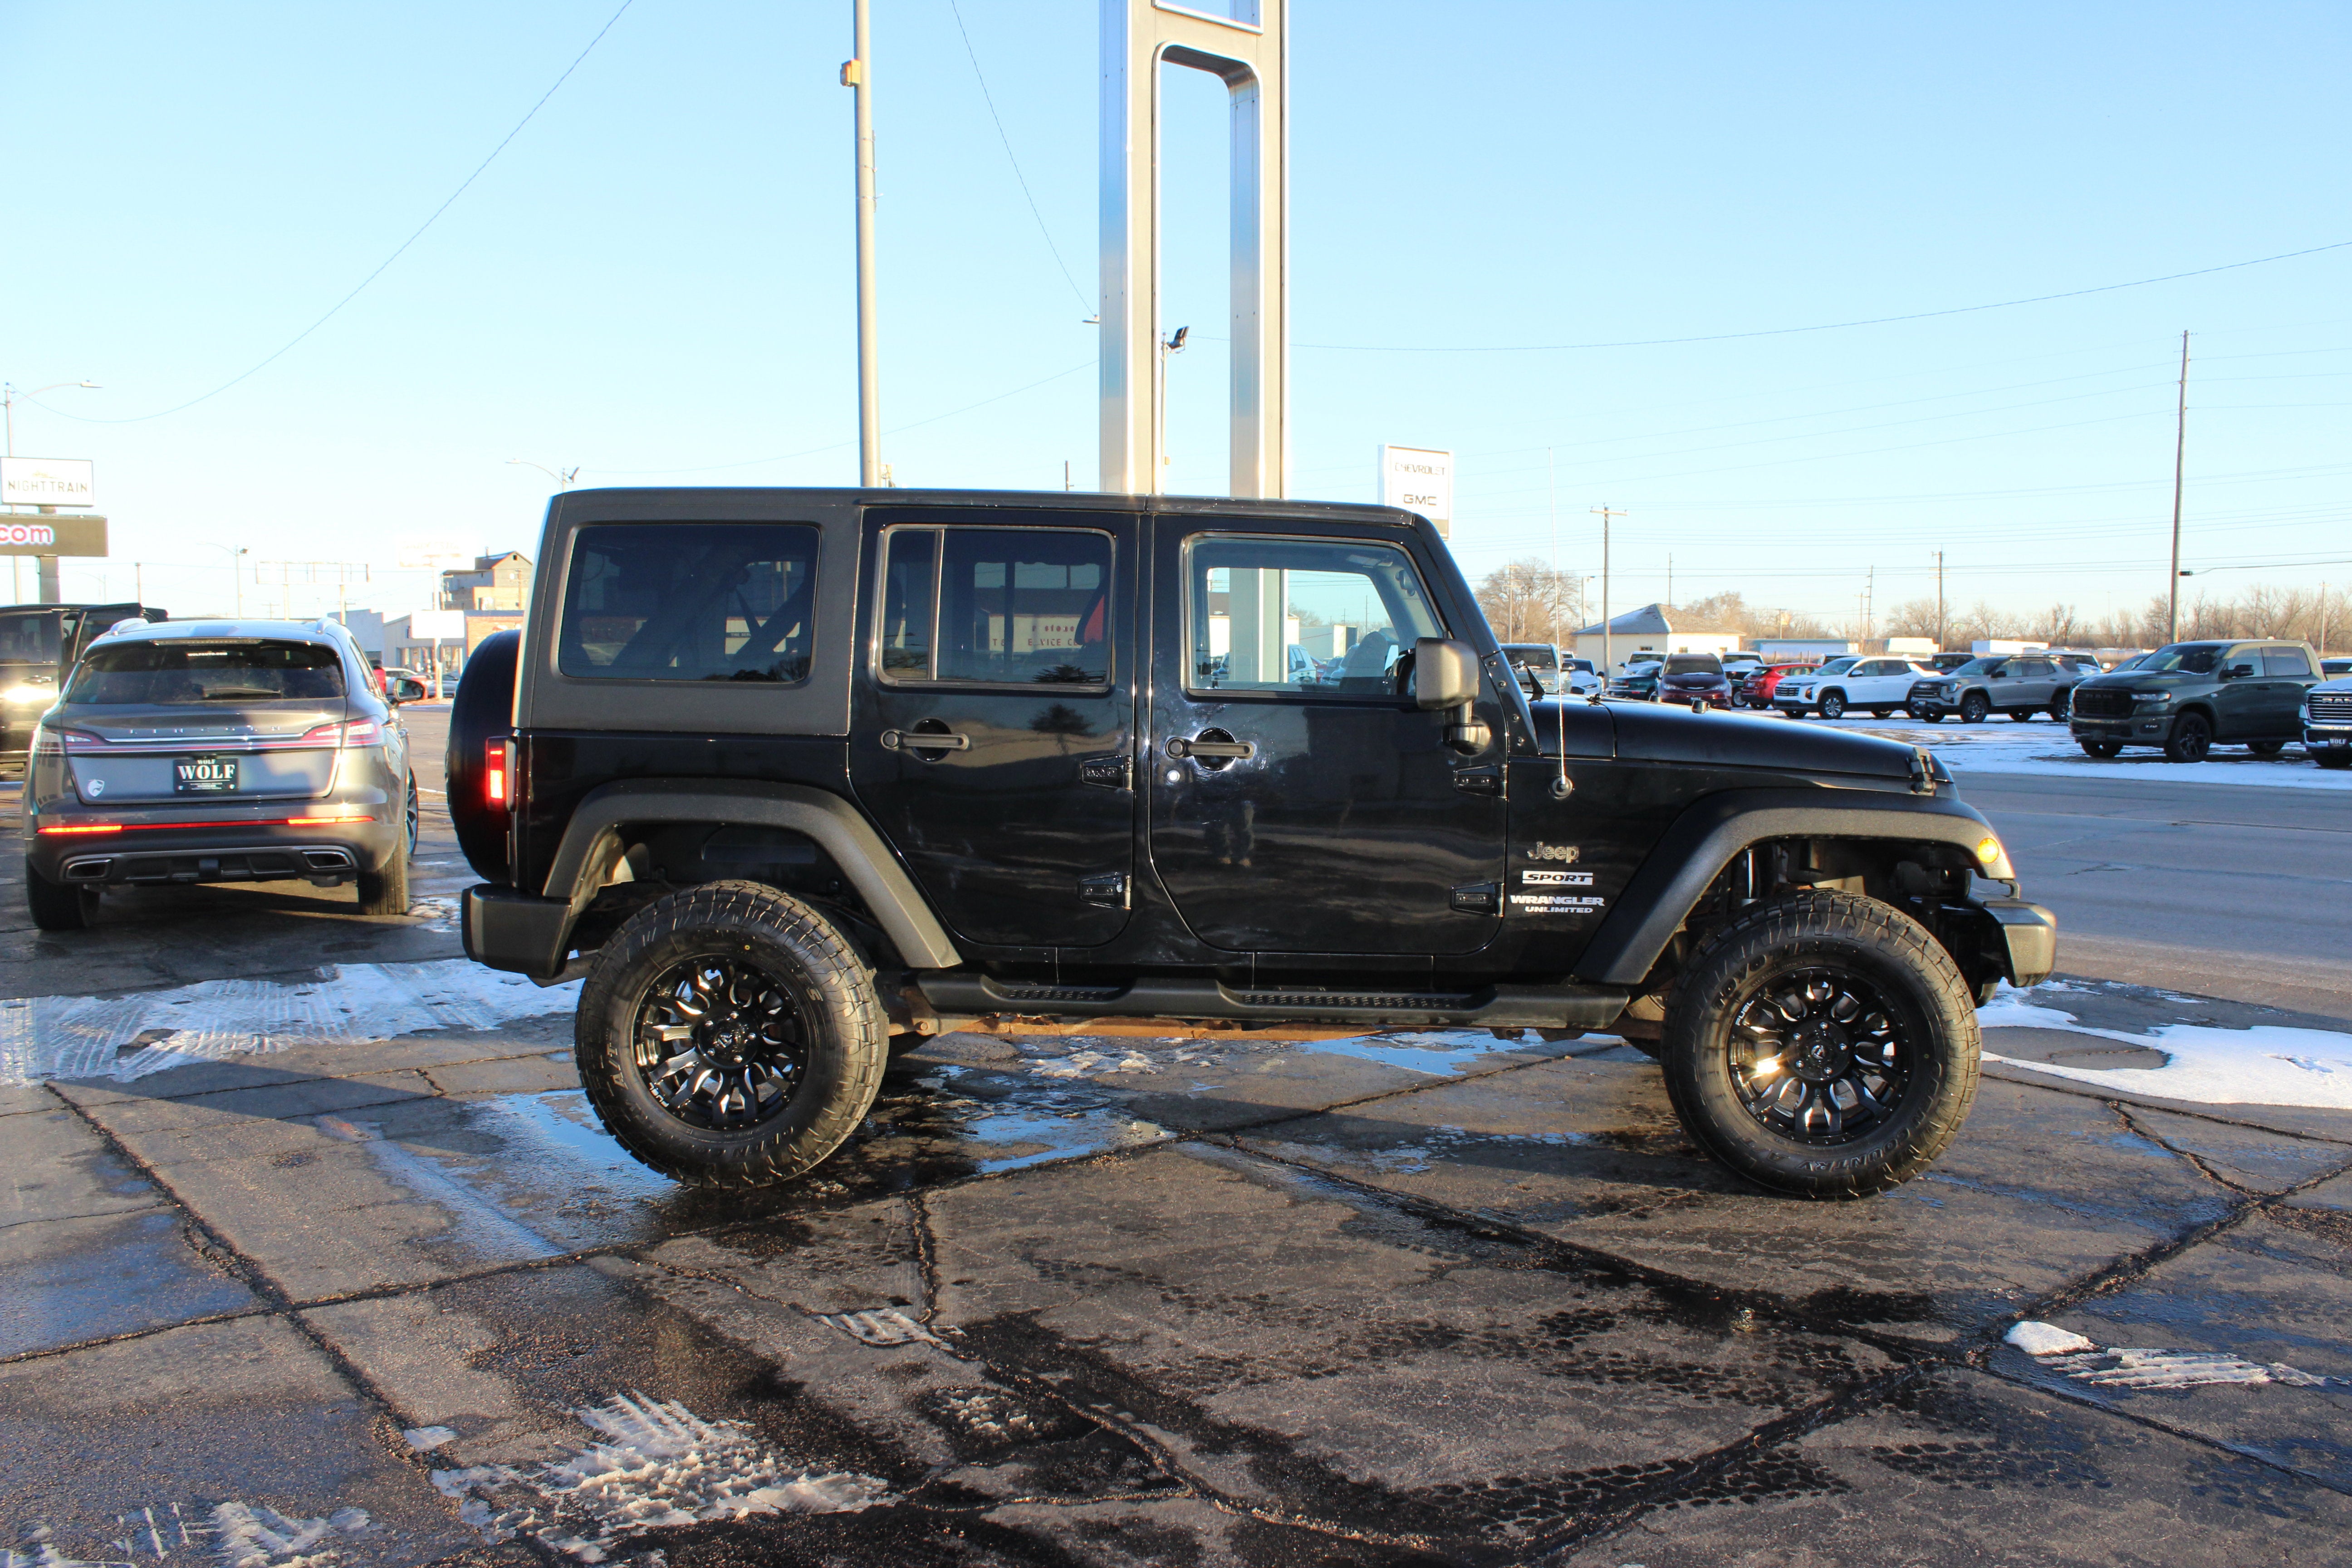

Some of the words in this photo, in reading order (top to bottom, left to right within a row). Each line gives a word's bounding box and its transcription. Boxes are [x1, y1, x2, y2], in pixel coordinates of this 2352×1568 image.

[1403, 494, 1437, 505] GMC
[177, 764, 235, 779] WOLF
[1527, 841, 1580, 863] Jeep
[1528, 874, 1588, 882] SPORT
[1509, 895, 1605, 906] WRANGLER
[1712, 953, 1768, 1011] TOYO
[1735, 1000, 1755, 1026] FUEL
[649, 1082, 670, 1108] FUEL
[1796, 1127, 1911, 1172] COUNTRY
